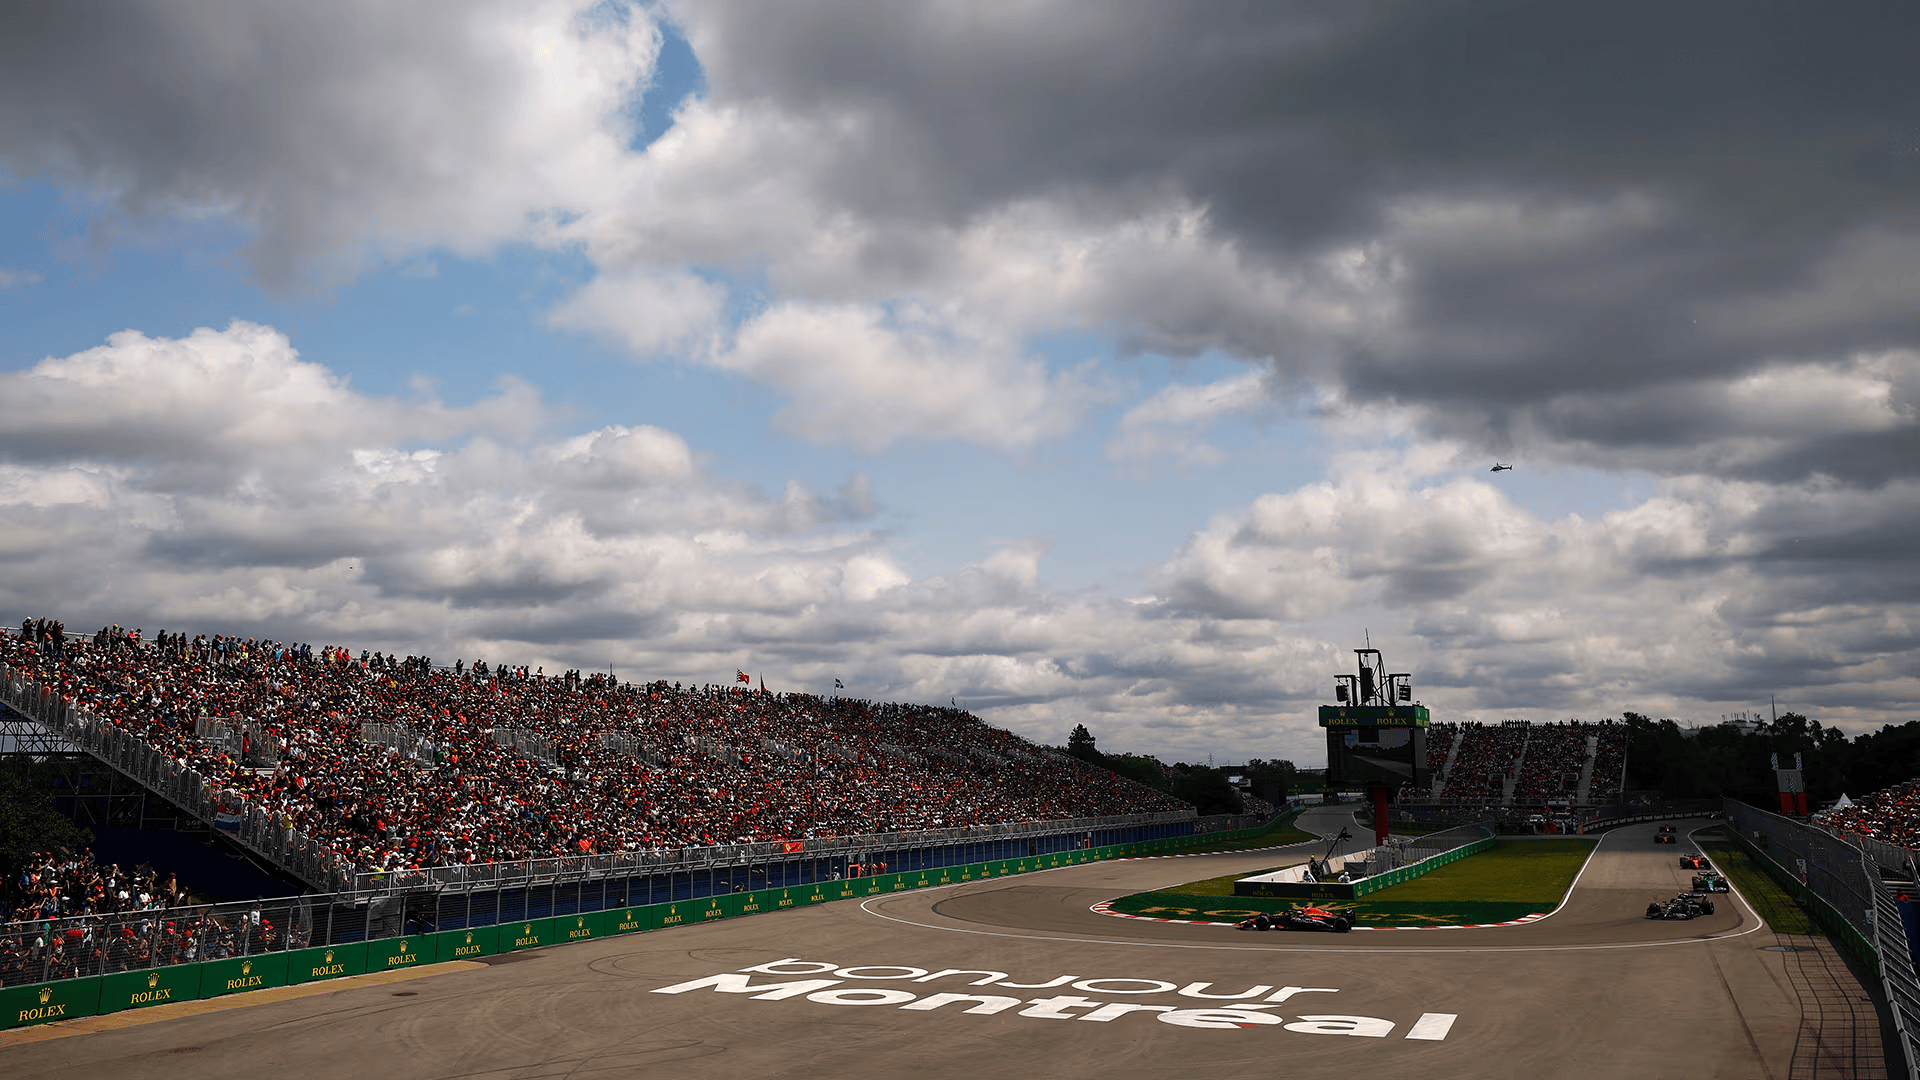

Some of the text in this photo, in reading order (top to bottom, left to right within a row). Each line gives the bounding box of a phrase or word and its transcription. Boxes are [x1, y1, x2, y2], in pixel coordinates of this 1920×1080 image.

[706, 909, 723, 919] ROLEX
[744, 904, 759, 913] ROLEX
[664, 915, 682, 925] ROLEX
[620, 922, 639, 932] ROLEX
[570, 929, 591, 940] ROLEX
[516, 937, 539, 949] ROLEX
[456, 946, 481, 958] ROLEX
[388, 954, 417, 966] ROLEX
[312, 965, 344, 978] ROLEX
[227, 976, 263, 991] ROLEX
[736, 958, 1340, 1002] bonjour
[131, 989, 171, 1004] ROLEX
[18, 1004, 65, 1021] ROLEX
[648, 973, 1458, 1041] Montréal
